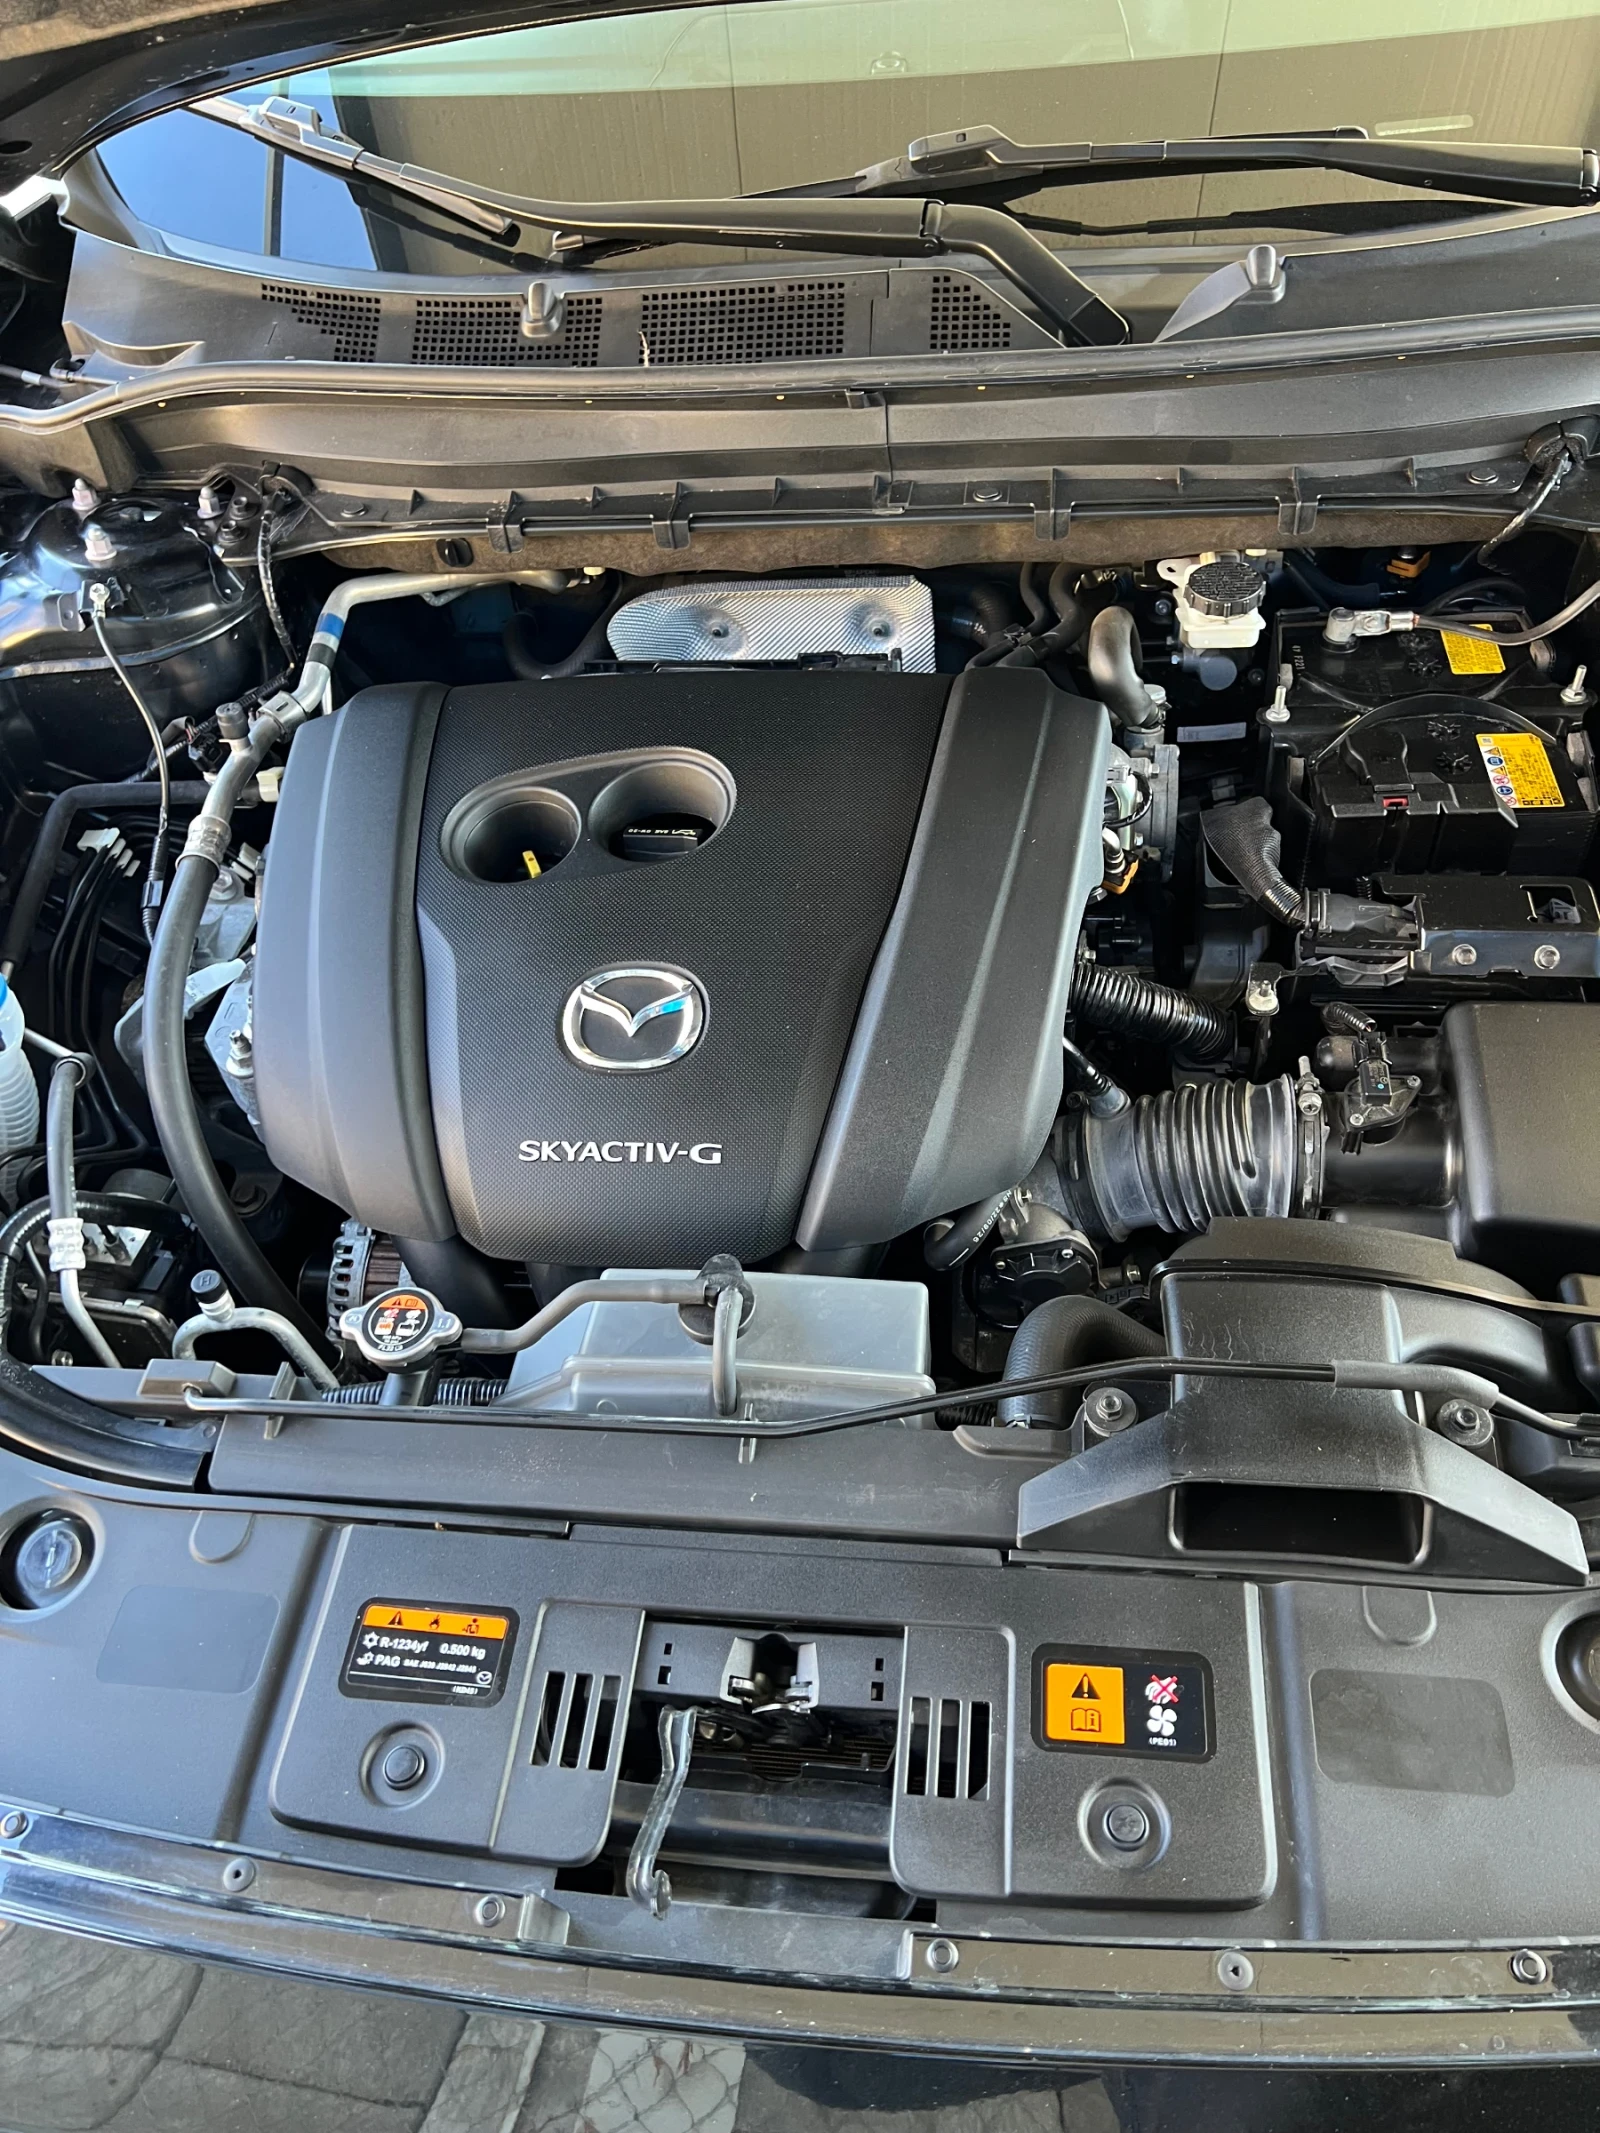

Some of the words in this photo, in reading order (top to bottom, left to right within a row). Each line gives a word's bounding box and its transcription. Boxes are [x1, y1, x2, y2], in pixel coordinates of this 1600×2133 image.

[518, 1140, 723, 1164] SKYACTIV-G
[380, 1636, 430, 1654] R-1234yf
[440, 1642, 471, 1657] 0.500
[471, 1645, 487, 1660] kg
[375, 1654, 401, 1668] PAG
